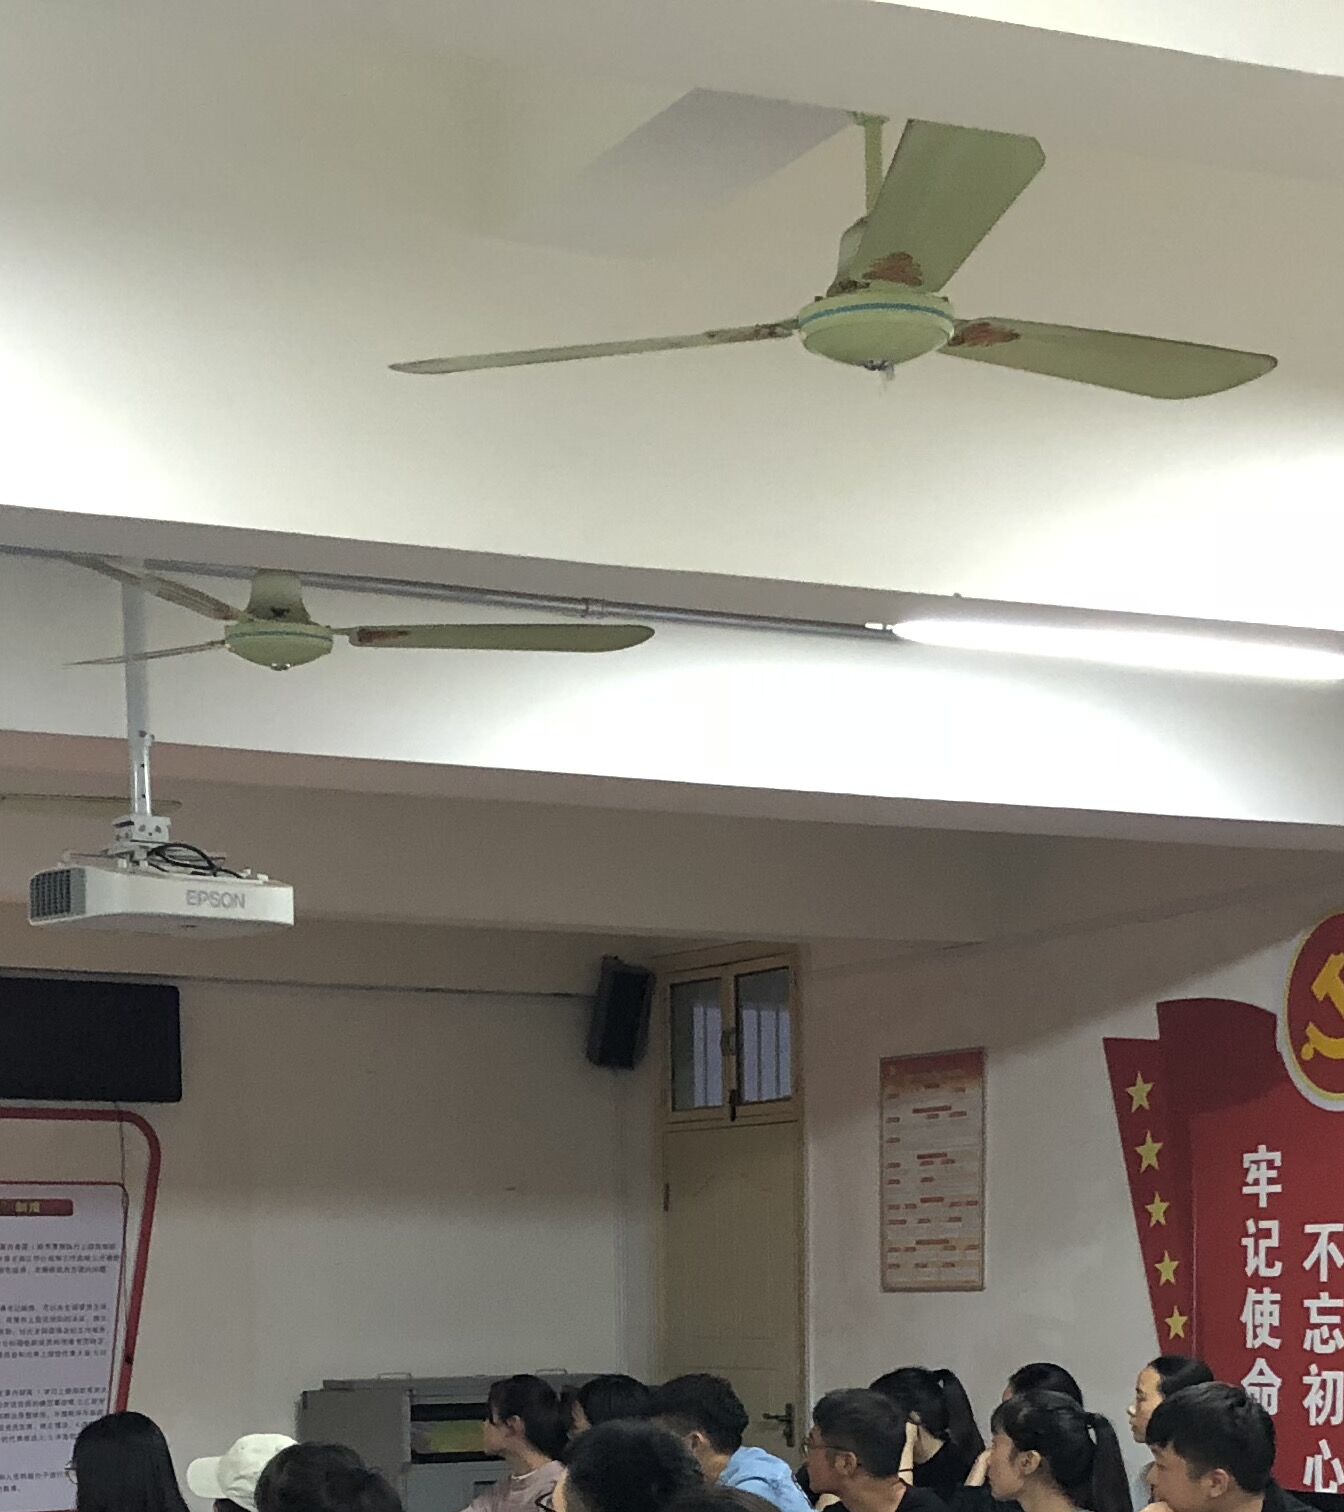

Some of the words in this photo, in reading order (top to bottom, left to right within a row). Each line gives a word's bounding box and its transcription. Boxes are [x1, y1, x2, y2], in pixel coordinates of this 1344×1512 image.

[186, 889, 246, 909] EPSON
[1240, 1145, 1283, 1416] 牢记使命
